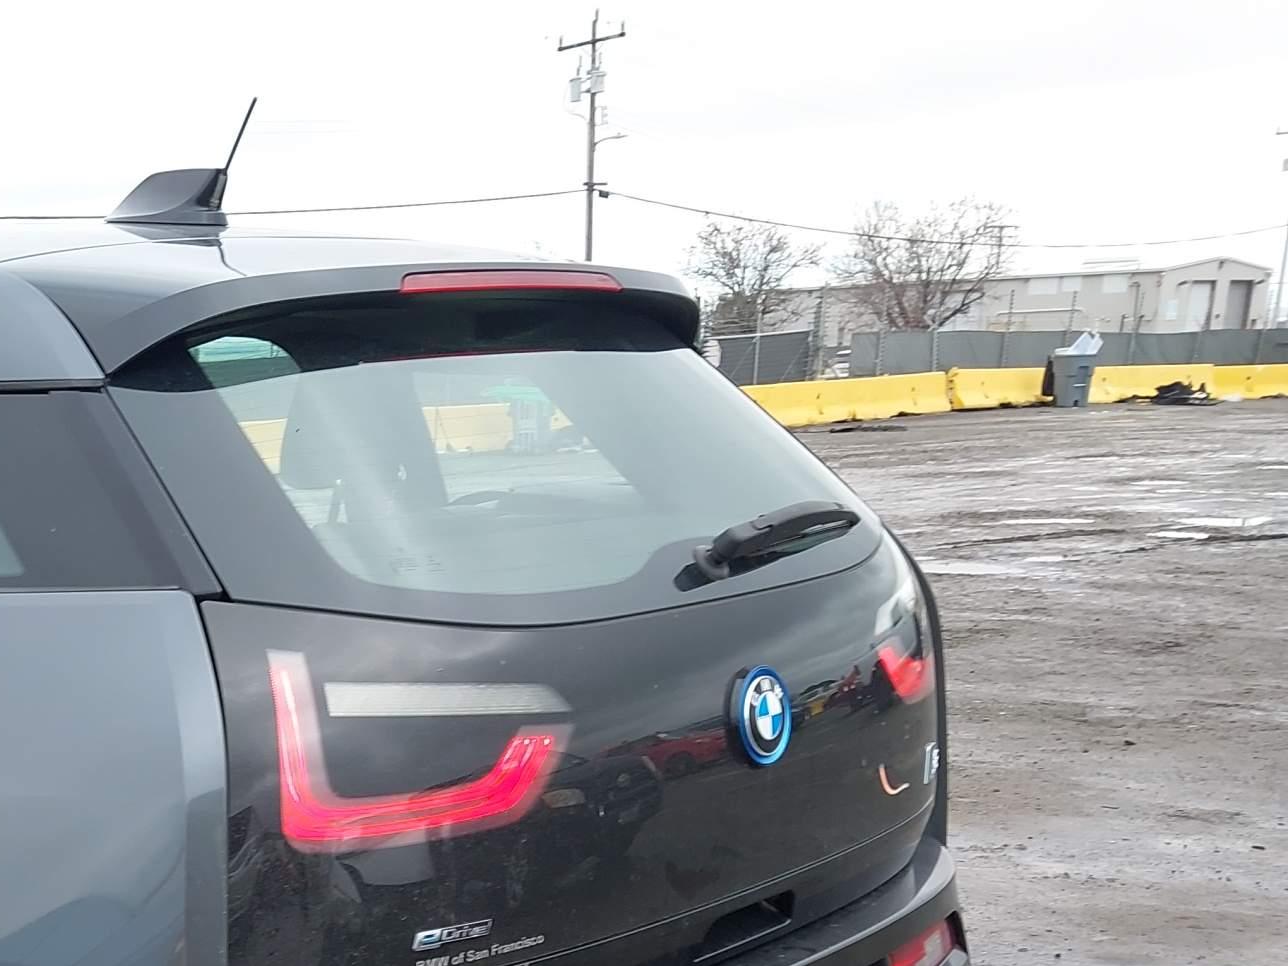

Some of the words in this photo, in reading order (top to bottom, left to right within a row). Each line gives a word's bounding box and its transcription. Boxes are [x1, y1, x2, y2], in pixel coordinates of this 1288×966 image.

[451, 951, 466, 965] of
[465, 949, 490, 962] San
[490, 935, 545, 956] Francisco
